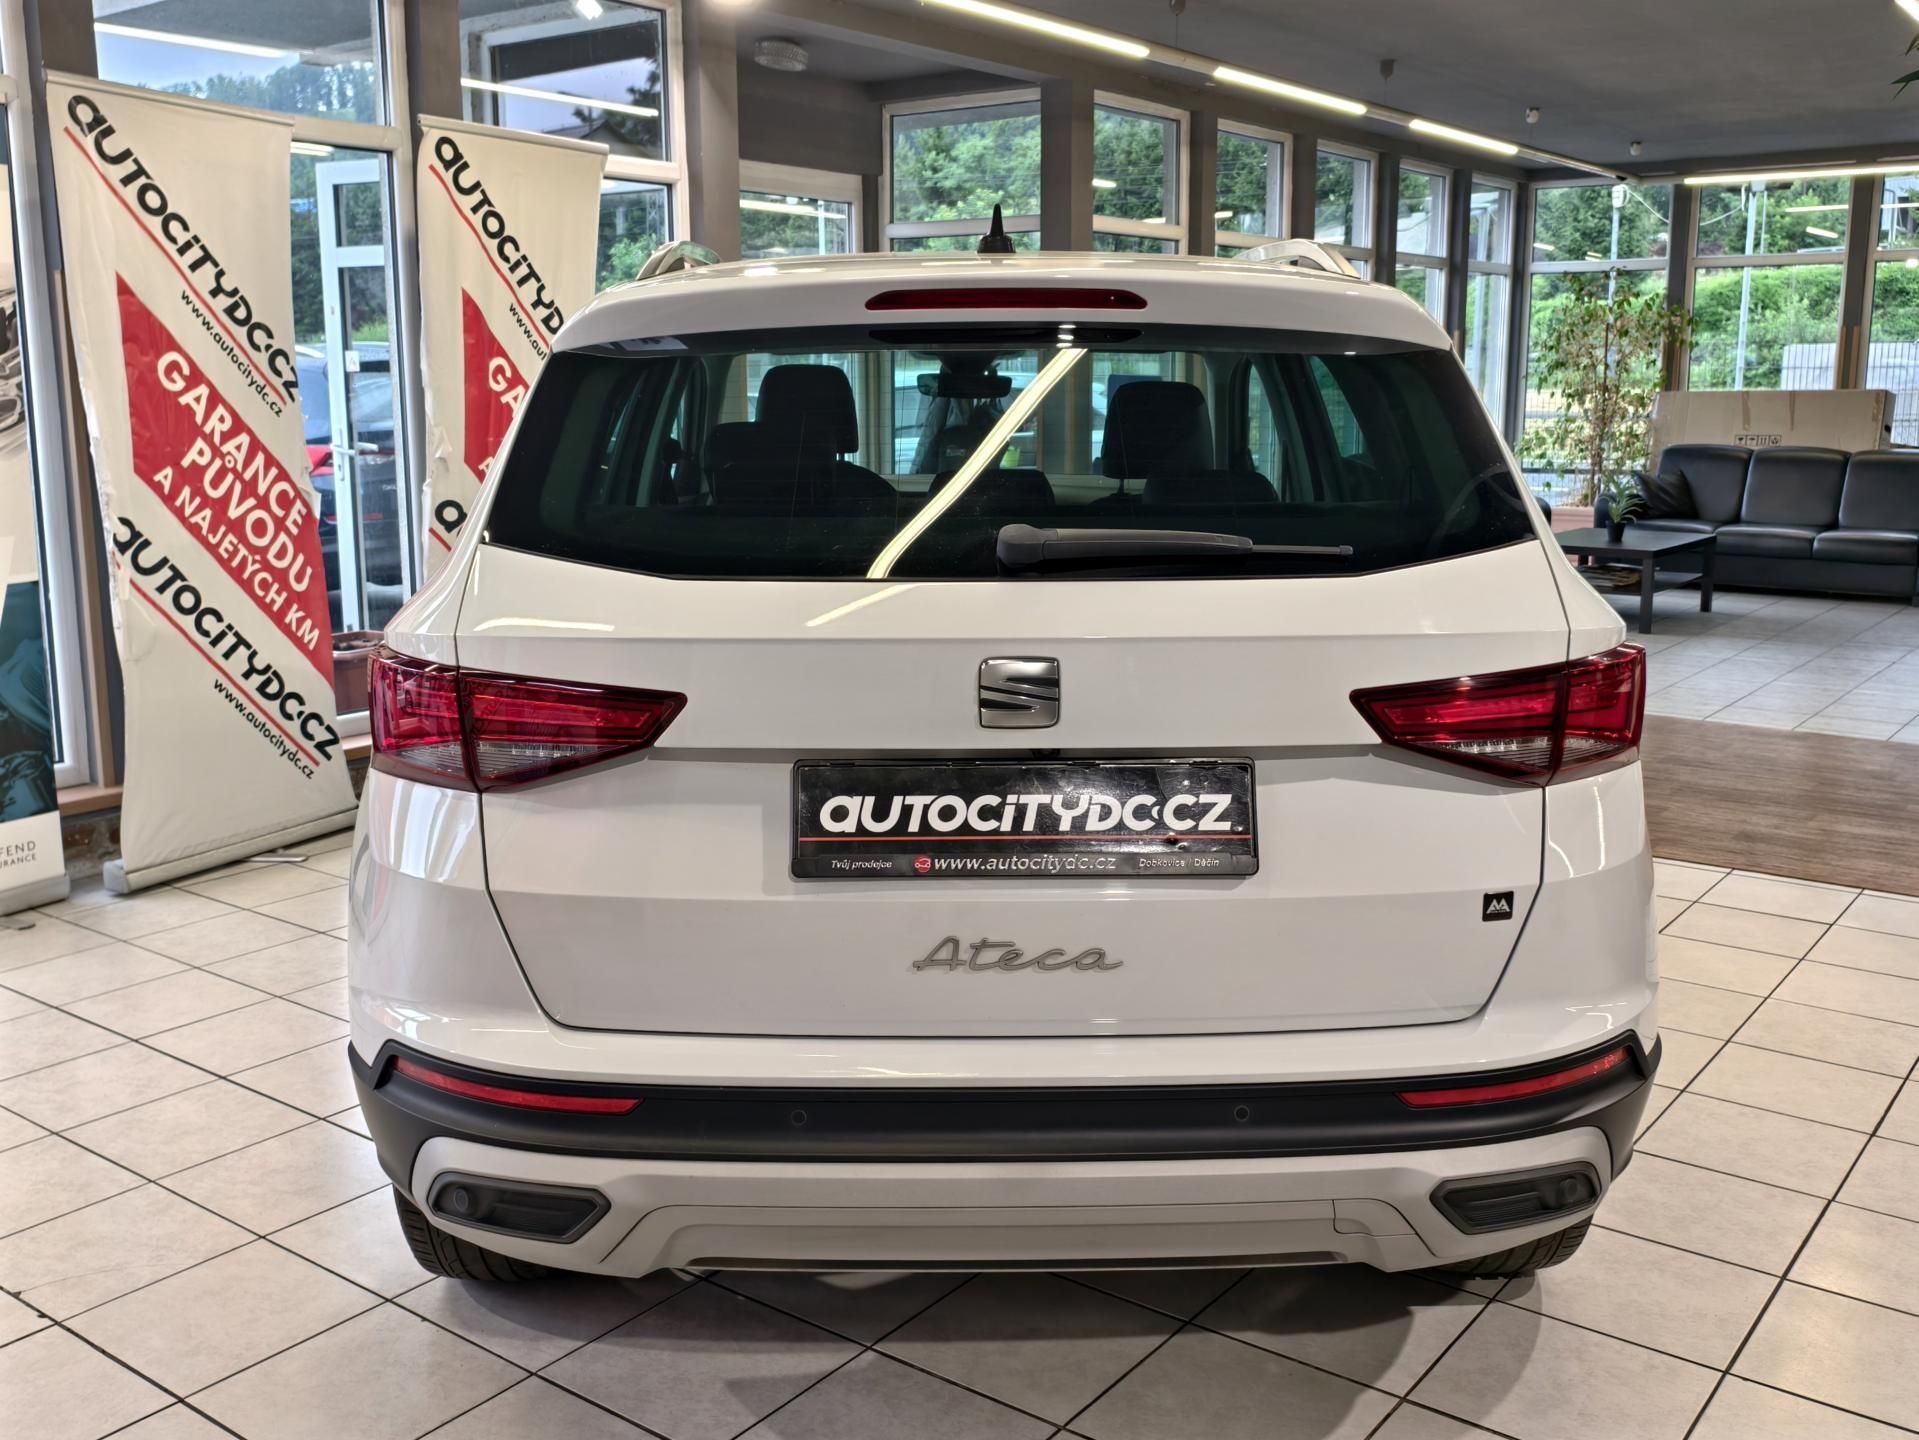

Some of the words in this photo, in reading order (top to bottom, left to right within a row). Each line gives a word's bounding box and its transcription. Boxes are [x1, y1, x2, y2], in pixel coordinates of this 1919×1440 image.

[181, 289, 283, 418] www.autocitydc.cz
[157, 351, 307, 536] GARANCE
[153, 466, 174, 495] A
[175, 486, 288, 613] NAJETÝCH
[285, 604, 321, 651] KM
[181, 437, 313, 593] PŮVODU
[214, 678, 315, 780] www.autocitydc.cz
[831, 859, 850, 872] Tvůj
[851, 860, 892, 871] prodejce
[934, 854, 1116, 873] www.autocitydc.cz
[913, 936, 1124, 972] Ateca
